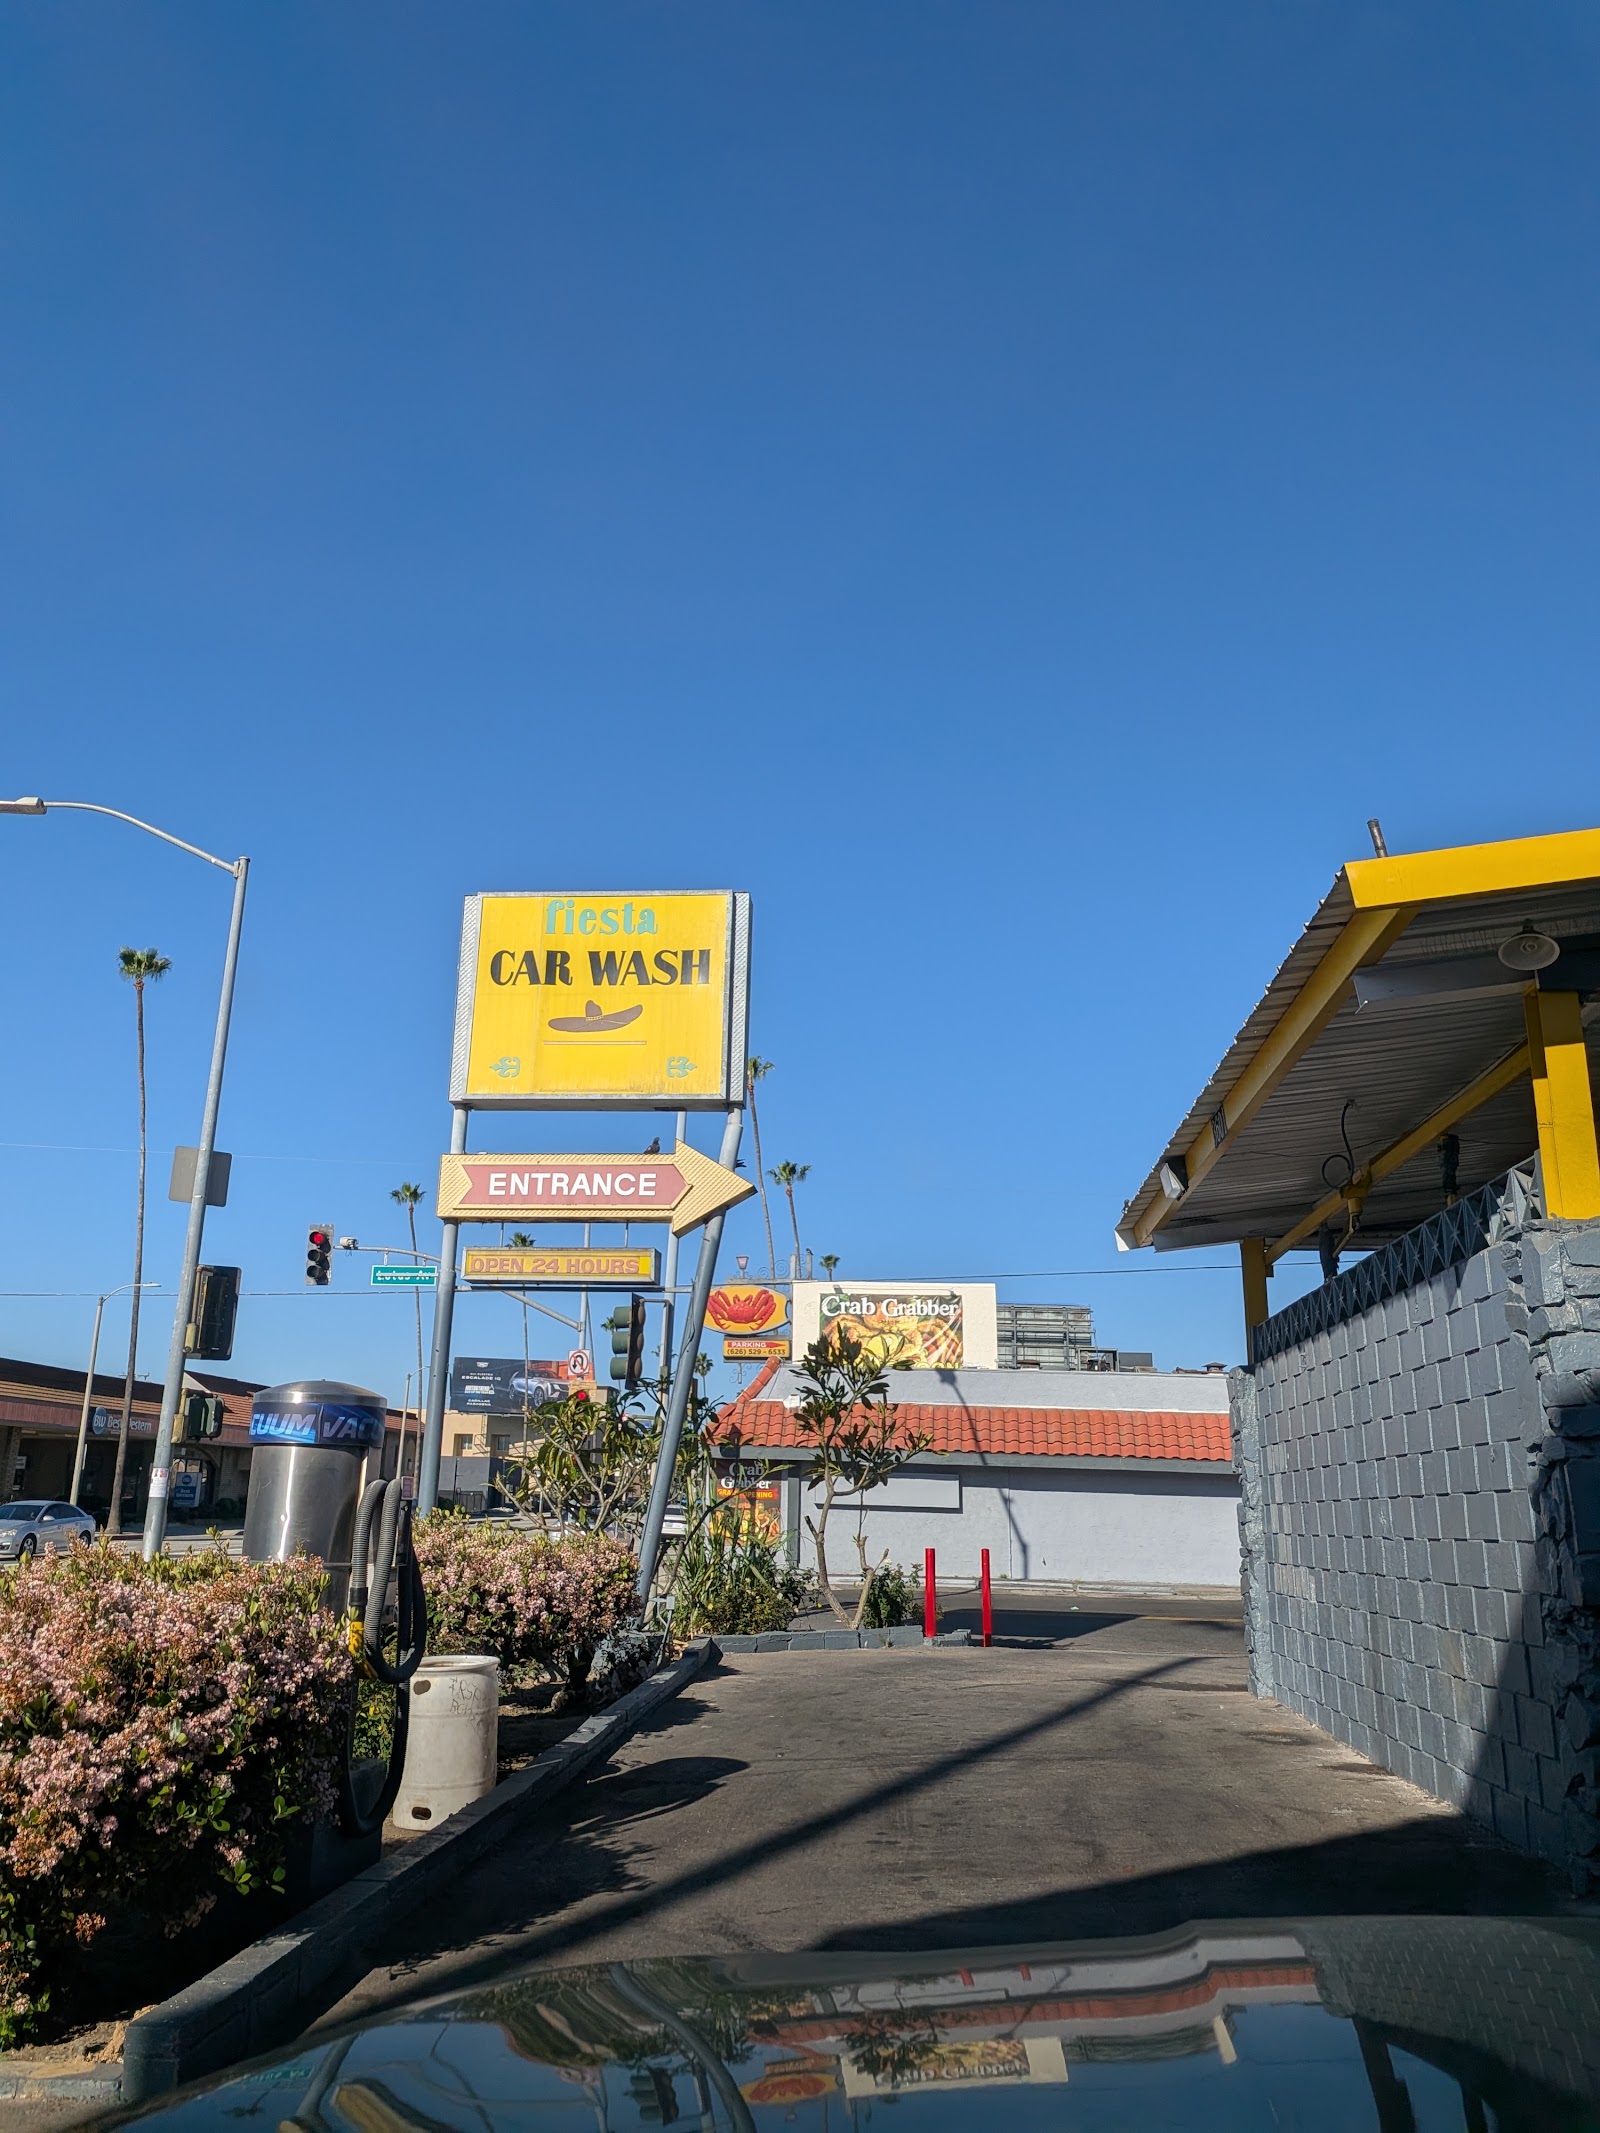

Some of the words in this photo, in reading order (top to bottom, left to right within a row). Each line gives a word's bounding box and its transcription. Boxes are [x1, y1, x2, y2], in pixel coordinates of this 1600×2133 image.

[545, 899, 658, 935] fiesta
[490, 949, 573, 986] CAR
[588, 949, 711, 986] WASH
[489, 1172, 656, 1196] ENTRANCE
[470, 1257, 524, 1273] OPEN
[530, 1258, 560, 1273] 24
[567, 1258, 640, 1274] HOURS
[821, 1295, 876, 1317] Crab
[881, 1298, 959, 1317] Grabber
[107, 1415, 121, 1430] Bes
[129, 1417, 152, 1431] estern
